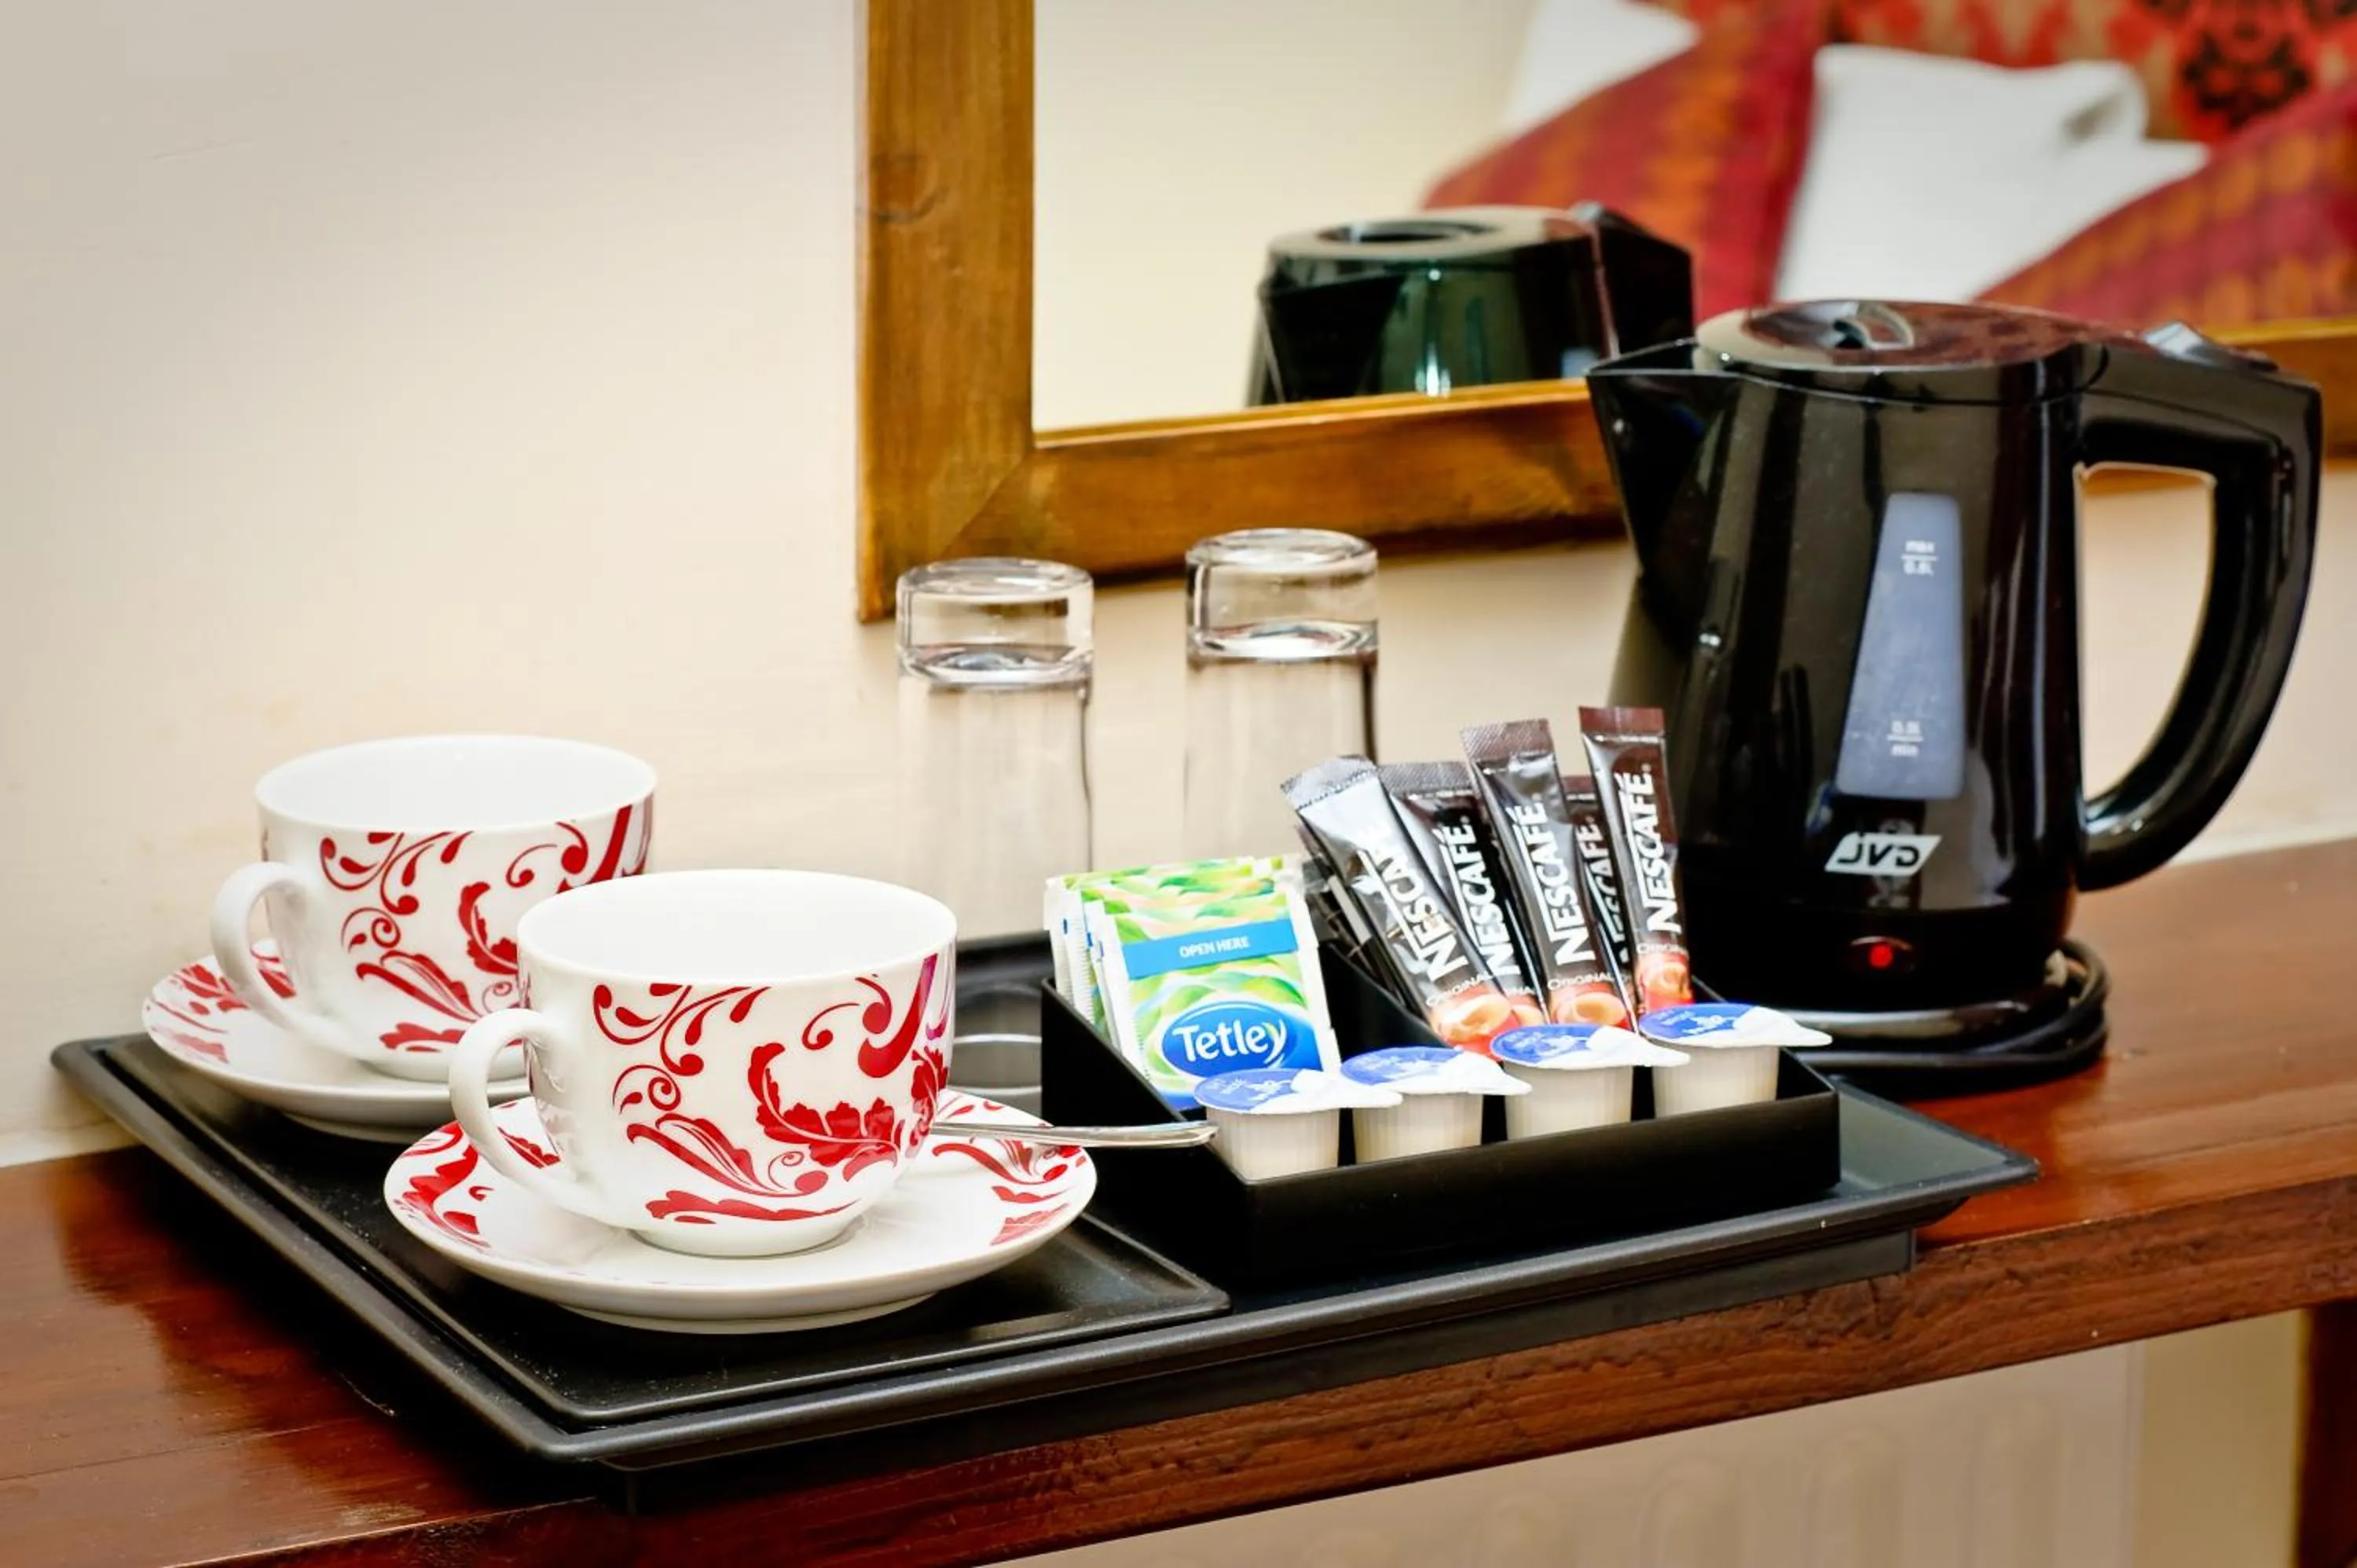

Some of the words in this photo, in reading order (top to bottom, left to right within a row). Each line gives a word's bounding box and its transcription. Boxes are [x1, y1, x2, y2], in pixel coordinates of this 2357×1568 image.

[1505, 801, 1596, 965] NESCAFÉ
[1614, 772, 1681, 933] NESCAFÉ
[1179, 942, 1215, 958] OPEN
[1216, 936, 1251, 953] HERE
[1171, 1019, 1287, 1064] Tetley
